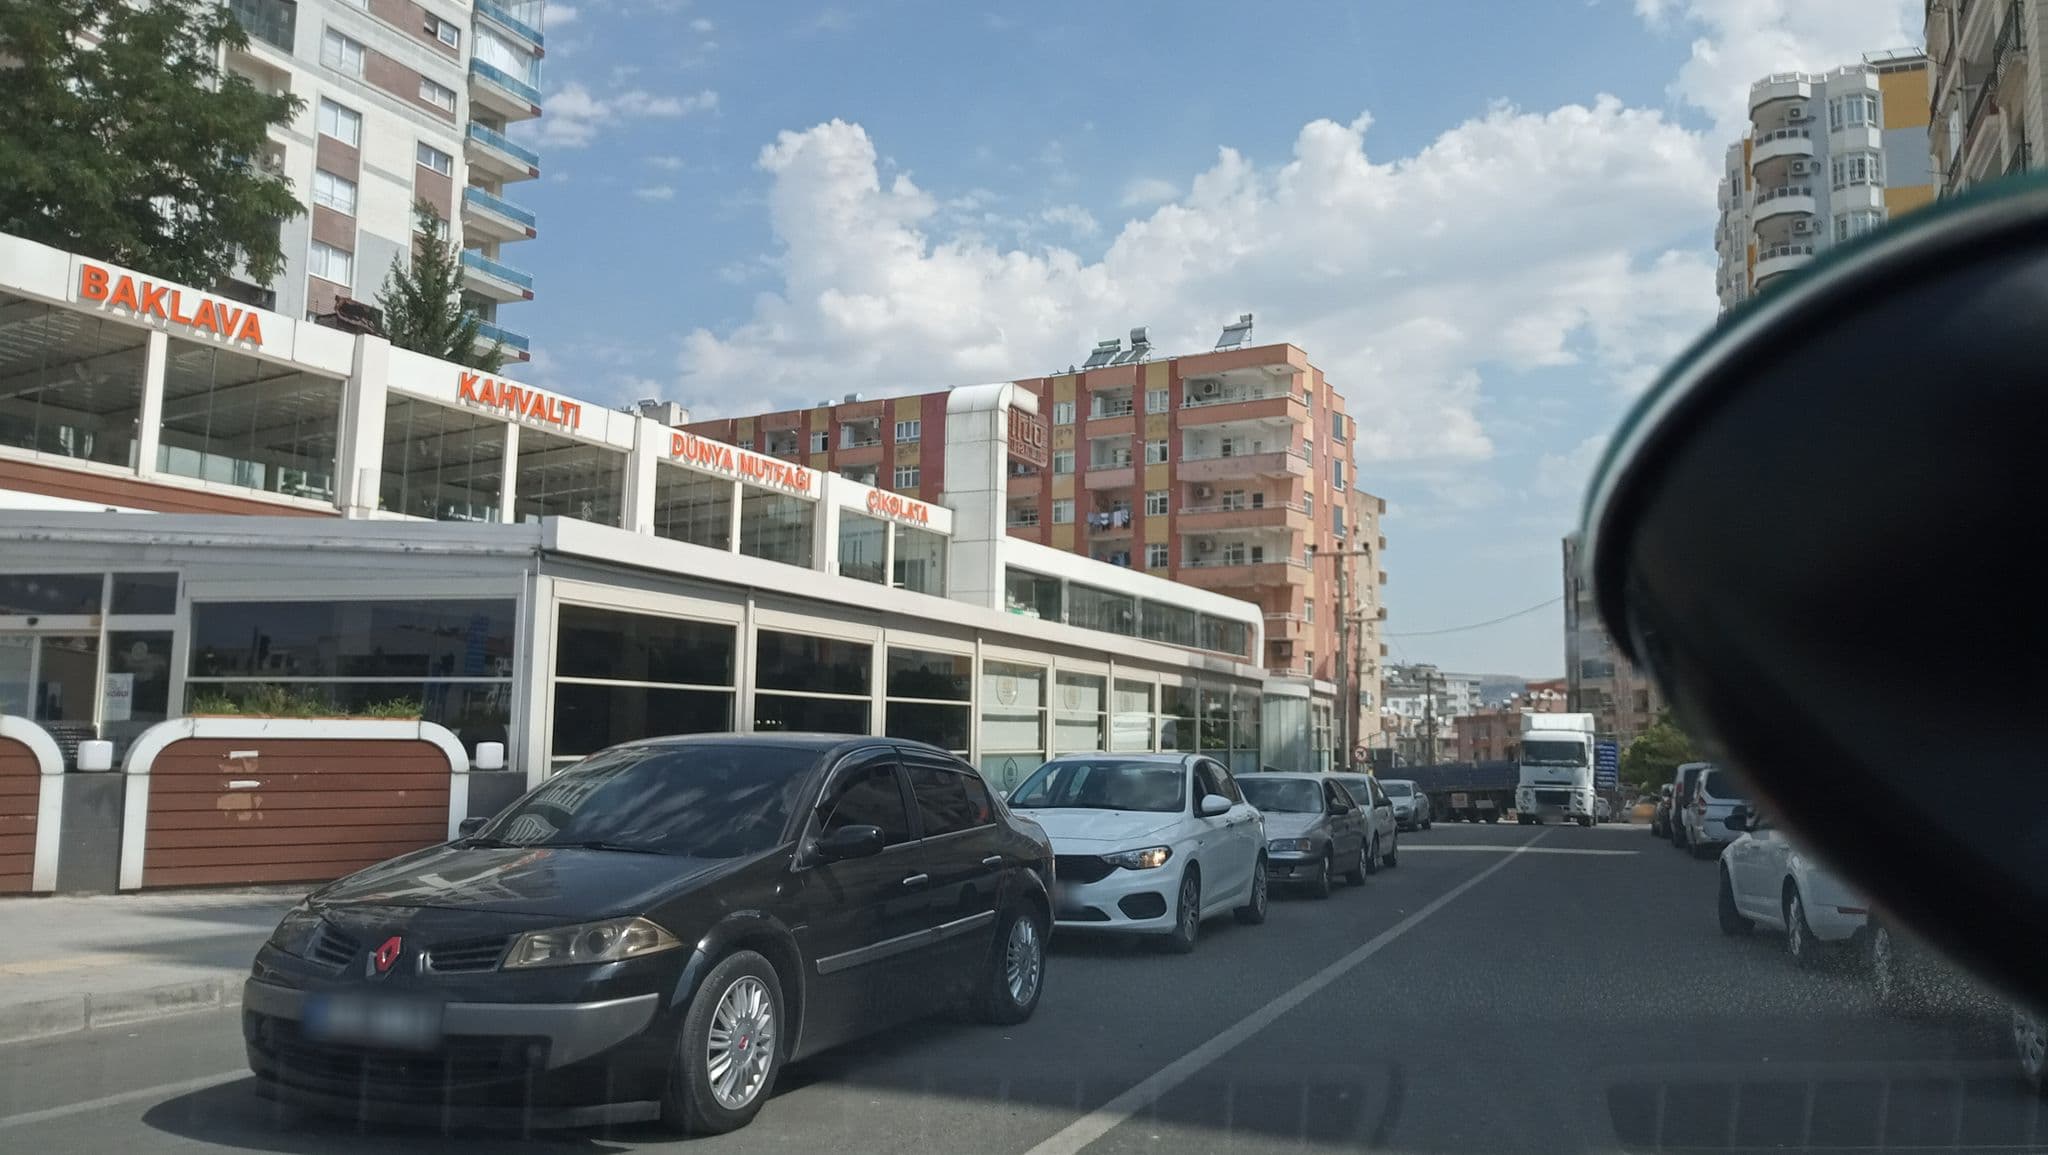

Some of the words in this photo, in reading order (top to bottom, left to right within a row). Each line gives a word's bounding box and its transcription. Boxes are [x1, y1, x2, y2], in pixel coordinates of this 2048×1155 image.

[82, 264, 263, 346] BAKLAVA
[459, 372, 581, 429] KAHVALTI
[672, 432, 734, 470] DÜNYA
[739, 451, 813, 491] MUTFAĞI
